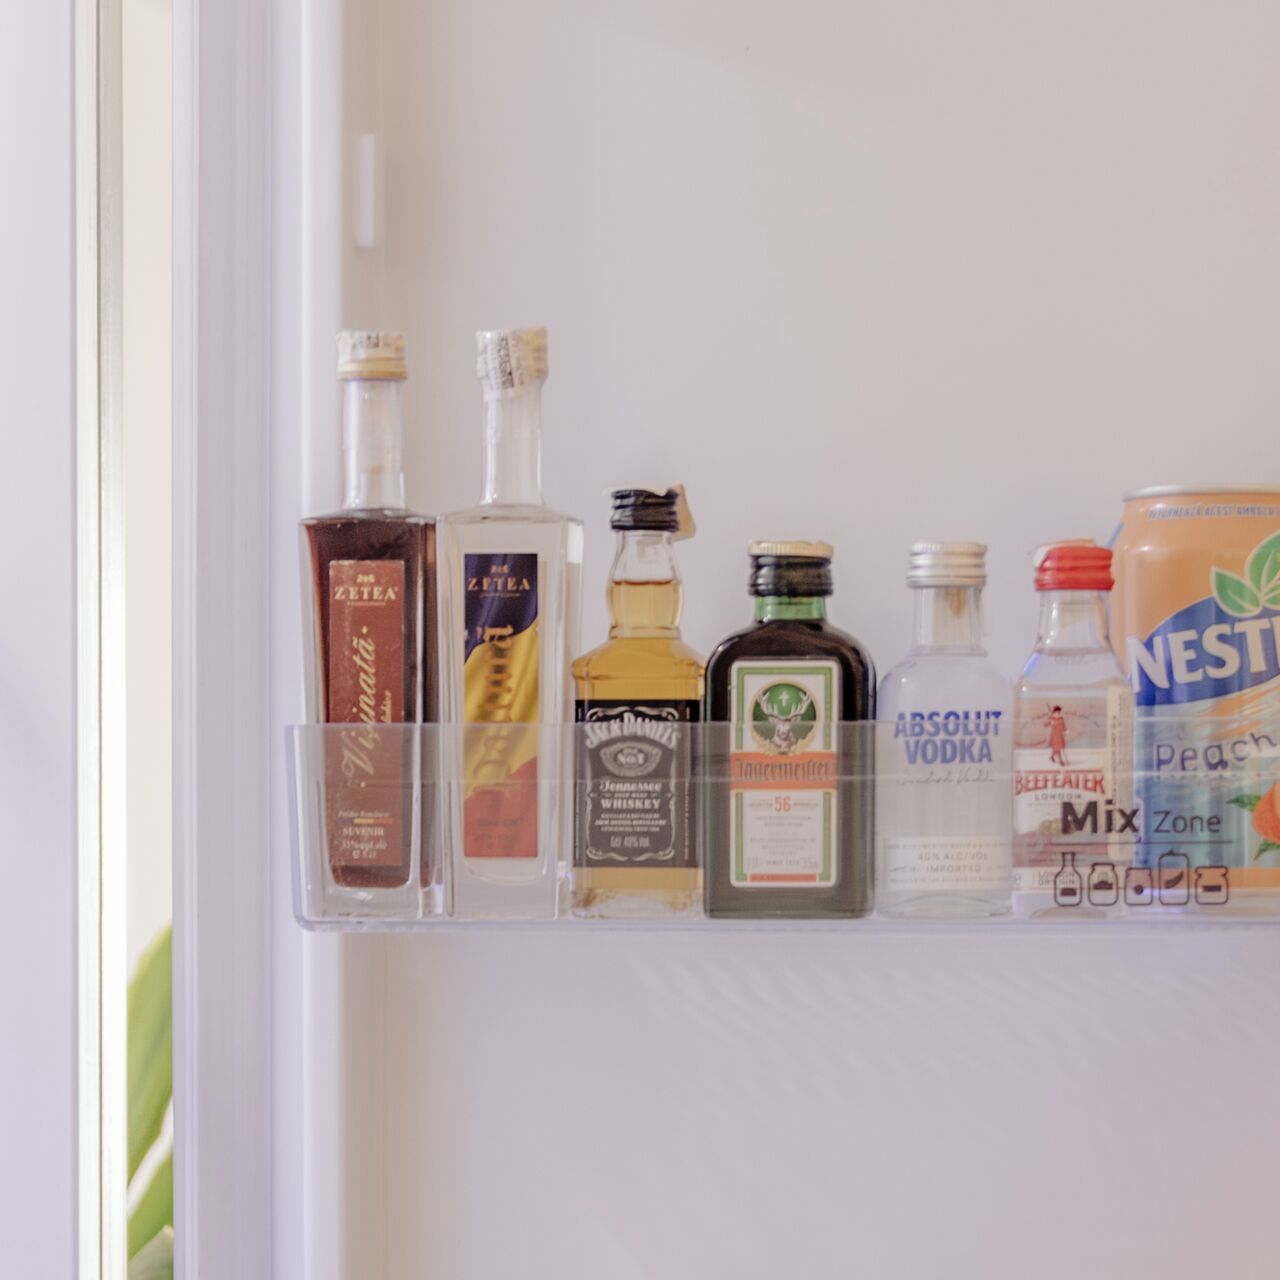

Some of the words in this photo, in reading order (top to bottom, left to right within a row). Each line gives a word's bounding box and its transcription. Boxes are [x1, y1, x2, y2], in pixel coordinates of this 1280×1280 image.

[334, 586, 396, 601] ZETEA
[468, 575, 531, 591] ZETEA
[894, 711, 1003, 739] ABSOLUT
[903, 738, 993, 765] VODKA
[1155, 732, 1278, 773] Peach
[600, 778, 662, 793] Tennessee
[1014, 768, 1106, 797] BEEFEATER
[601, 798, 661, 810] WHISKEY
[774, 796, 792, 812] 56
[1061, 799, 1140, 834] Mix
[1153, 810, 1222, 833] Zone
